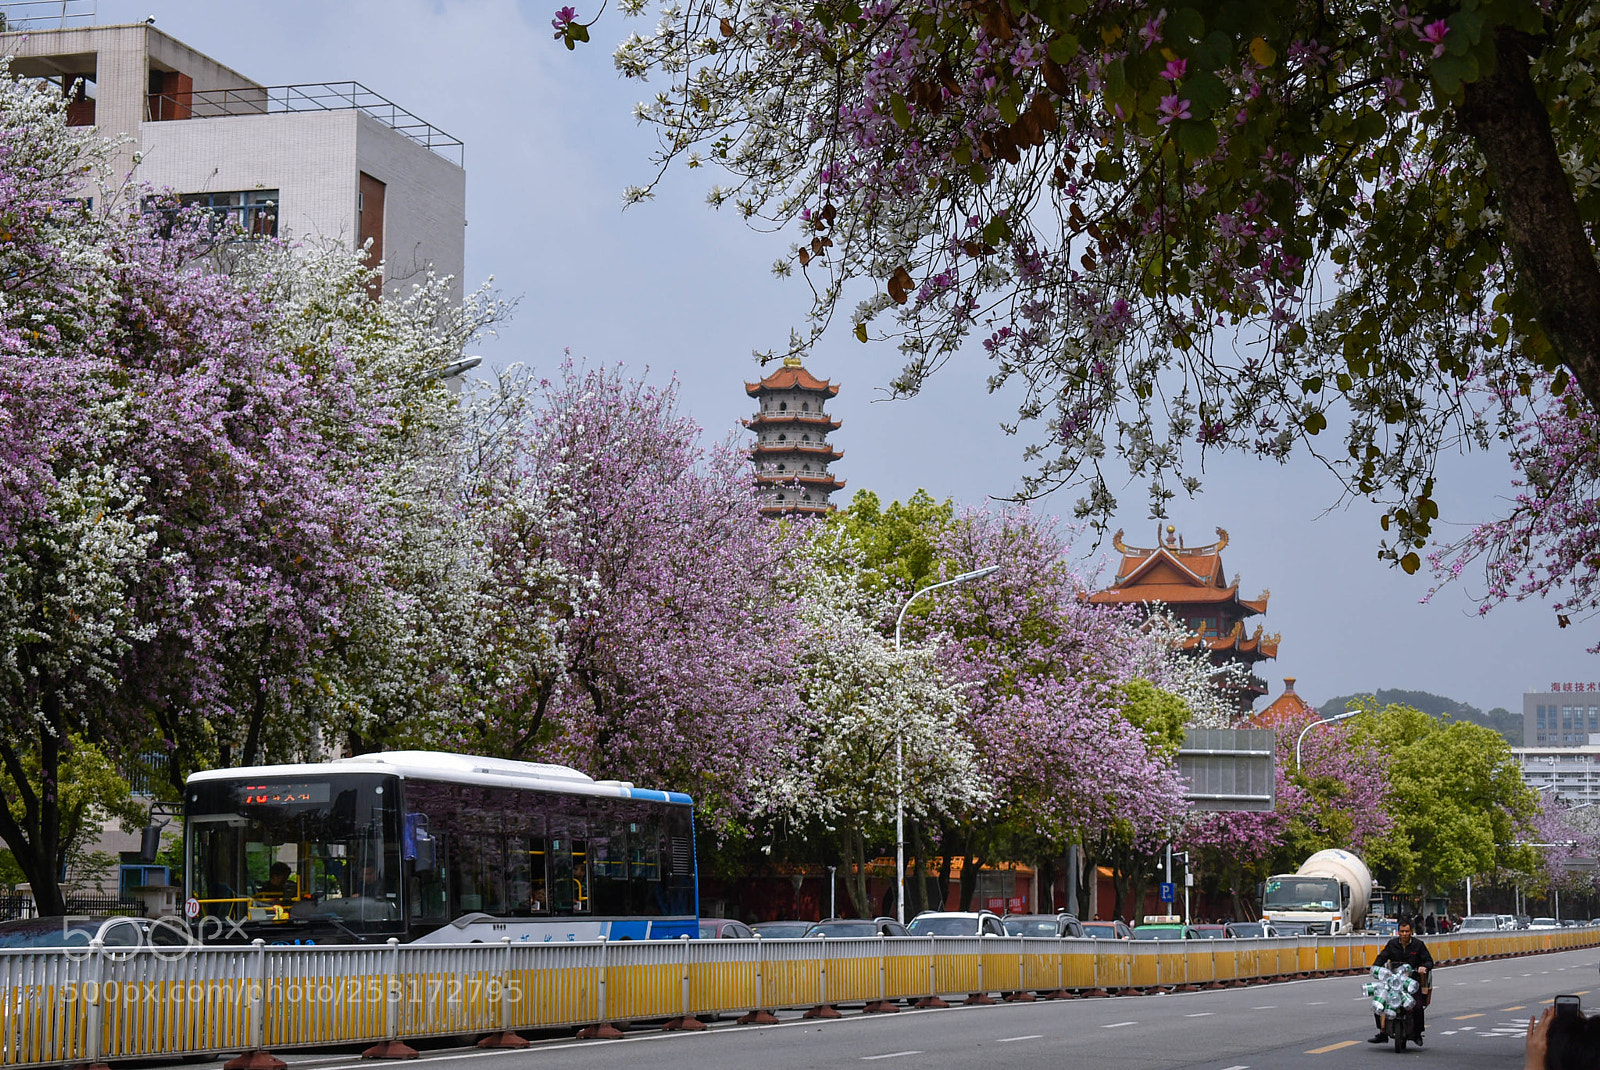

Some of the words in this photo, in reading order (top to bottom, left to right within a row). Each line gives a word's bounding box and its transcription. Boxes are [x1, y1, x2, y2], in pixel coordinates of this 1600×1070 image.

[1551, 682, 1600, 692] 海峡技术
[1162, 885, 1170, 899] P
[187, 902, 197, 913] 70
